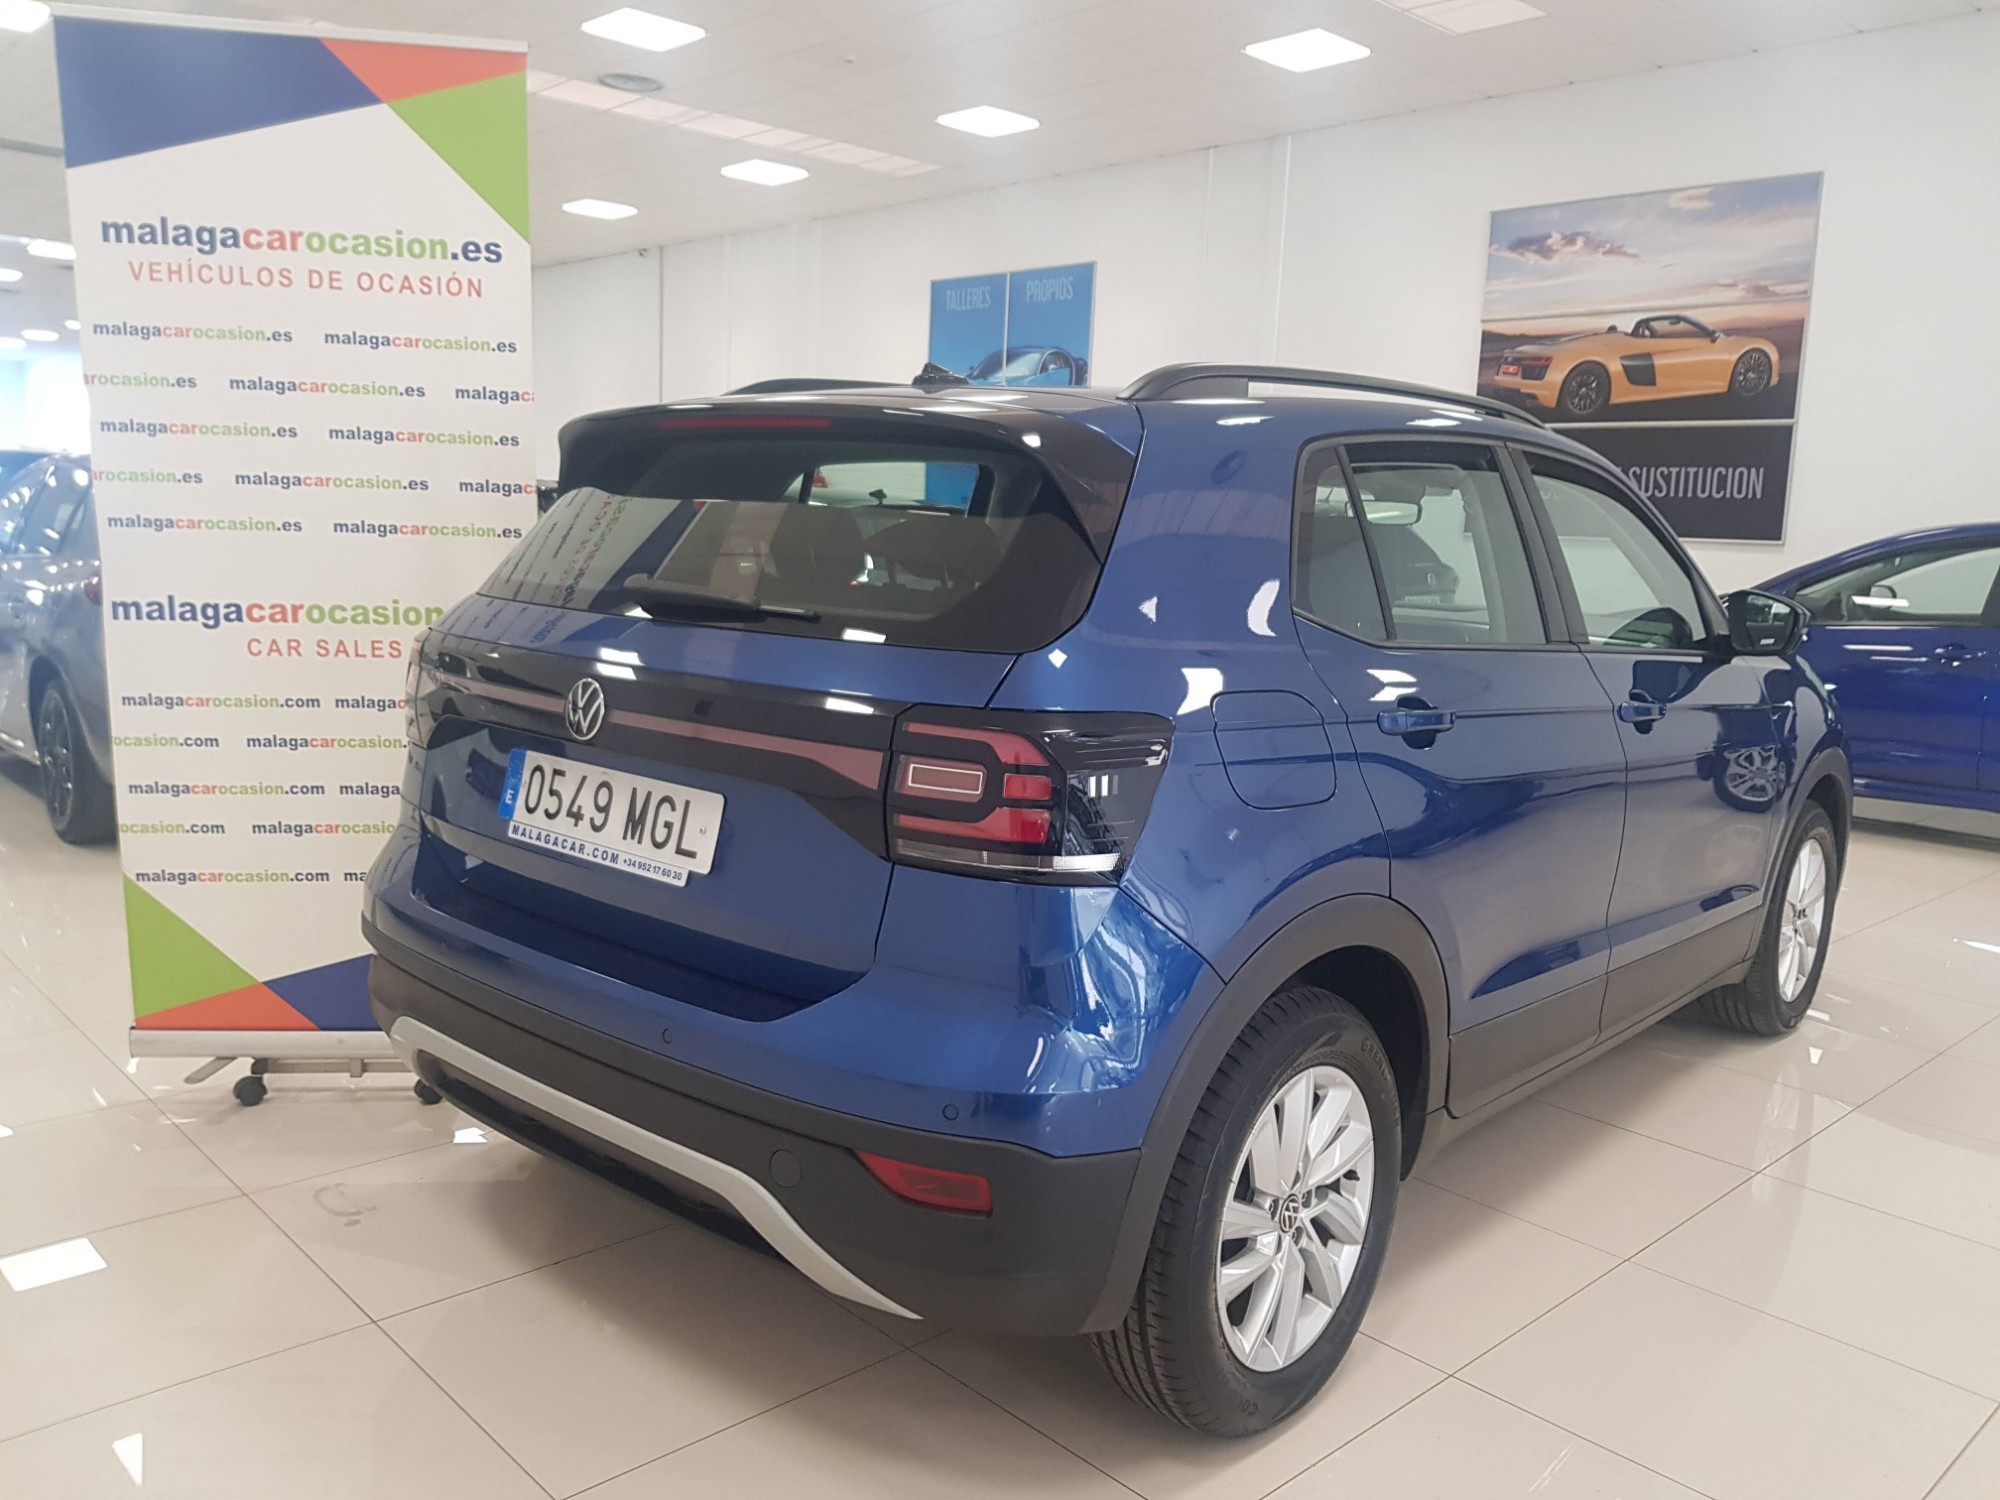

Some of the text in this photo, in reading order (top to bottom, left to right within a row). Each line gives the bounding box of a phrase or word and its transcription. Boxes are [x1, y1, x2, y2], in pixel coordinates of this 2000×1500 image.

[101, 216, 503, 263] malagacarocasion.es
[128, 258, 482, 298] VEHÍCULOS DE OCASIÓN
[946, 277, 1074, 311] TALLERES PROPIOS
[93, 322, 517, 353] malagacarocasion.es malagacarocasion.es
[230, 377, 426, 397] malagacarocasion.es
[455, 386, 535, 404] malagac
[100, 419, 520, 447] malagacarocasion.es malagacarocasion.es
[235, 471, 430, 491] malagacarocasion.es
[1628, 466, 1764, 499] SUSTITUCION
[107, 514, 522, 539] malagacarocasion.es malagacarocasion.es
[111, 595, 445, 630] malagacarocasion
[247, 638, 403, 659] CAR SALES
[121, 693, 321, 710] malagacarocasion.com
[128, 781, 325, 798] malagacarocasion.com
[505, 790, 514, 804] E
[524, 764, 698, 859] 0549 MGL
[512, 825, 619, 865] MALAGACAR.COM
[136, 869, 330, 885] malagacarocasion.com
